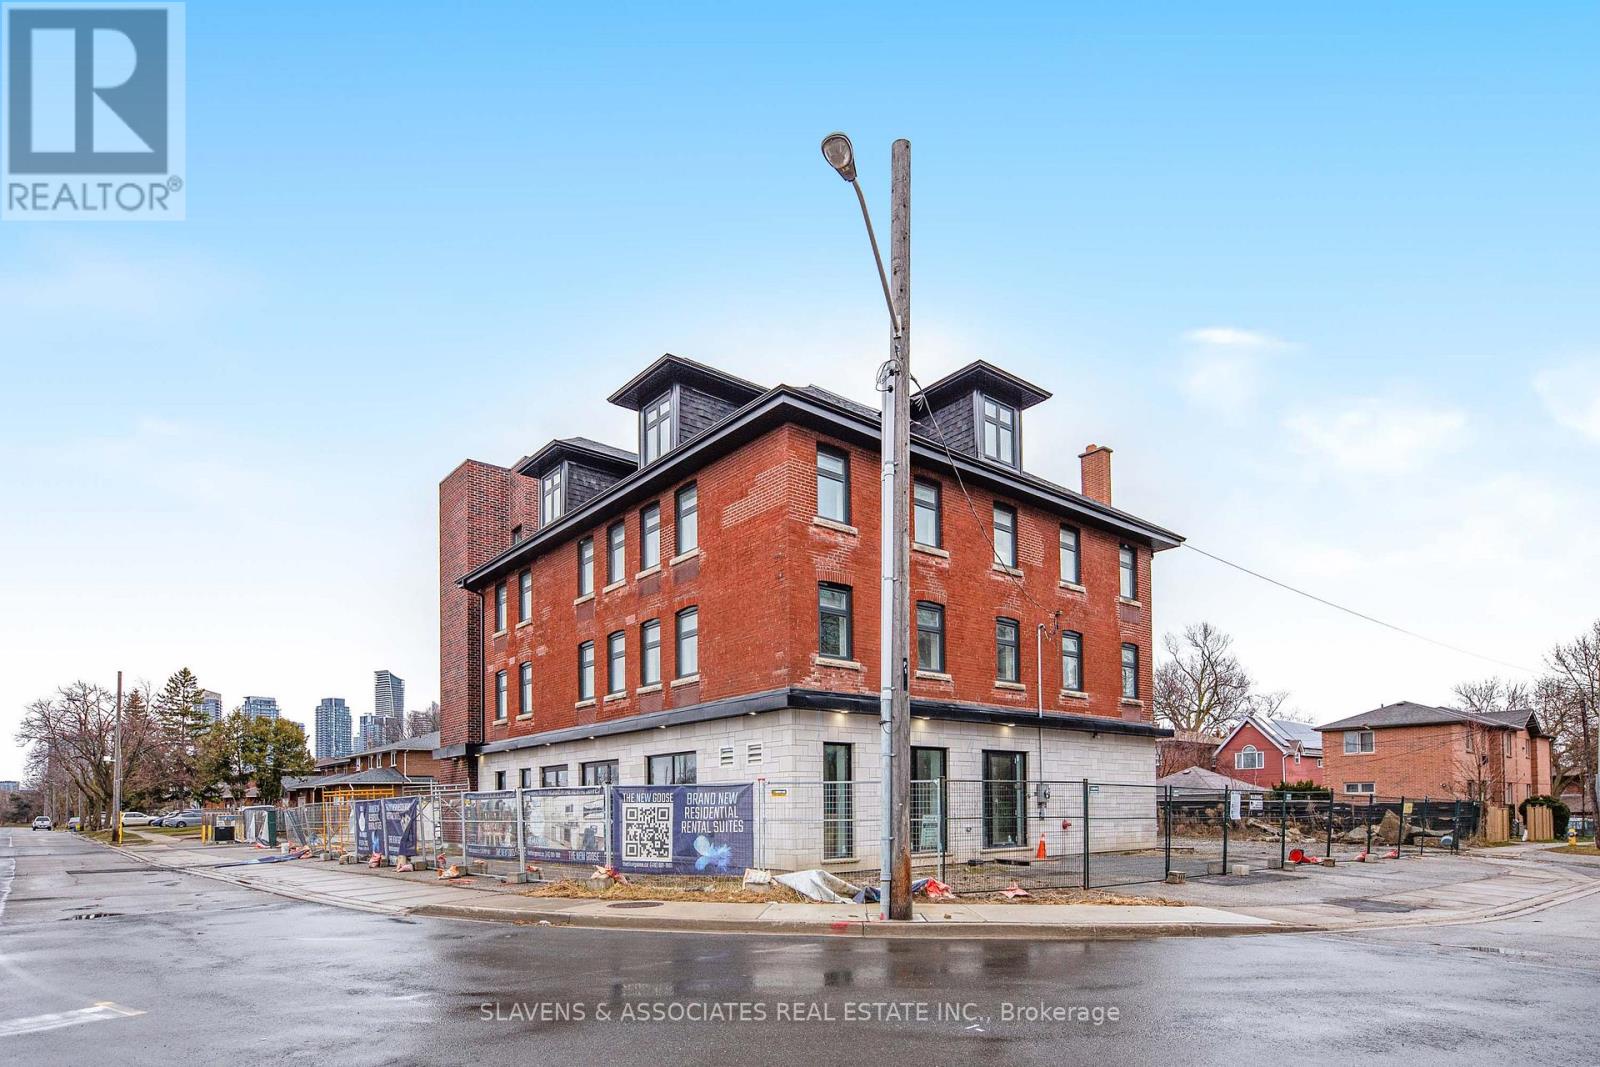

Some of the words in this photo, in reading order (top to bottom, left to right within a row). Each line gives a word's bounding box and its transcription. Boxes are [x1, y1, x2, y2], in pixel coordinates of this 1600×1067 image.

[623, 793, 635, 803] THE
[636, 793, 651, 803] NEW
[652, 793, 674, 803] GOOSE
[686, 792, 716, 806] BRAND
[718, 792, 739, 805] NEW
[684, 806, 739, 820] RESIDENTIAL
[681, 820, 711, 834] RENTAL
[713, 820, 744, 833] SUITES
